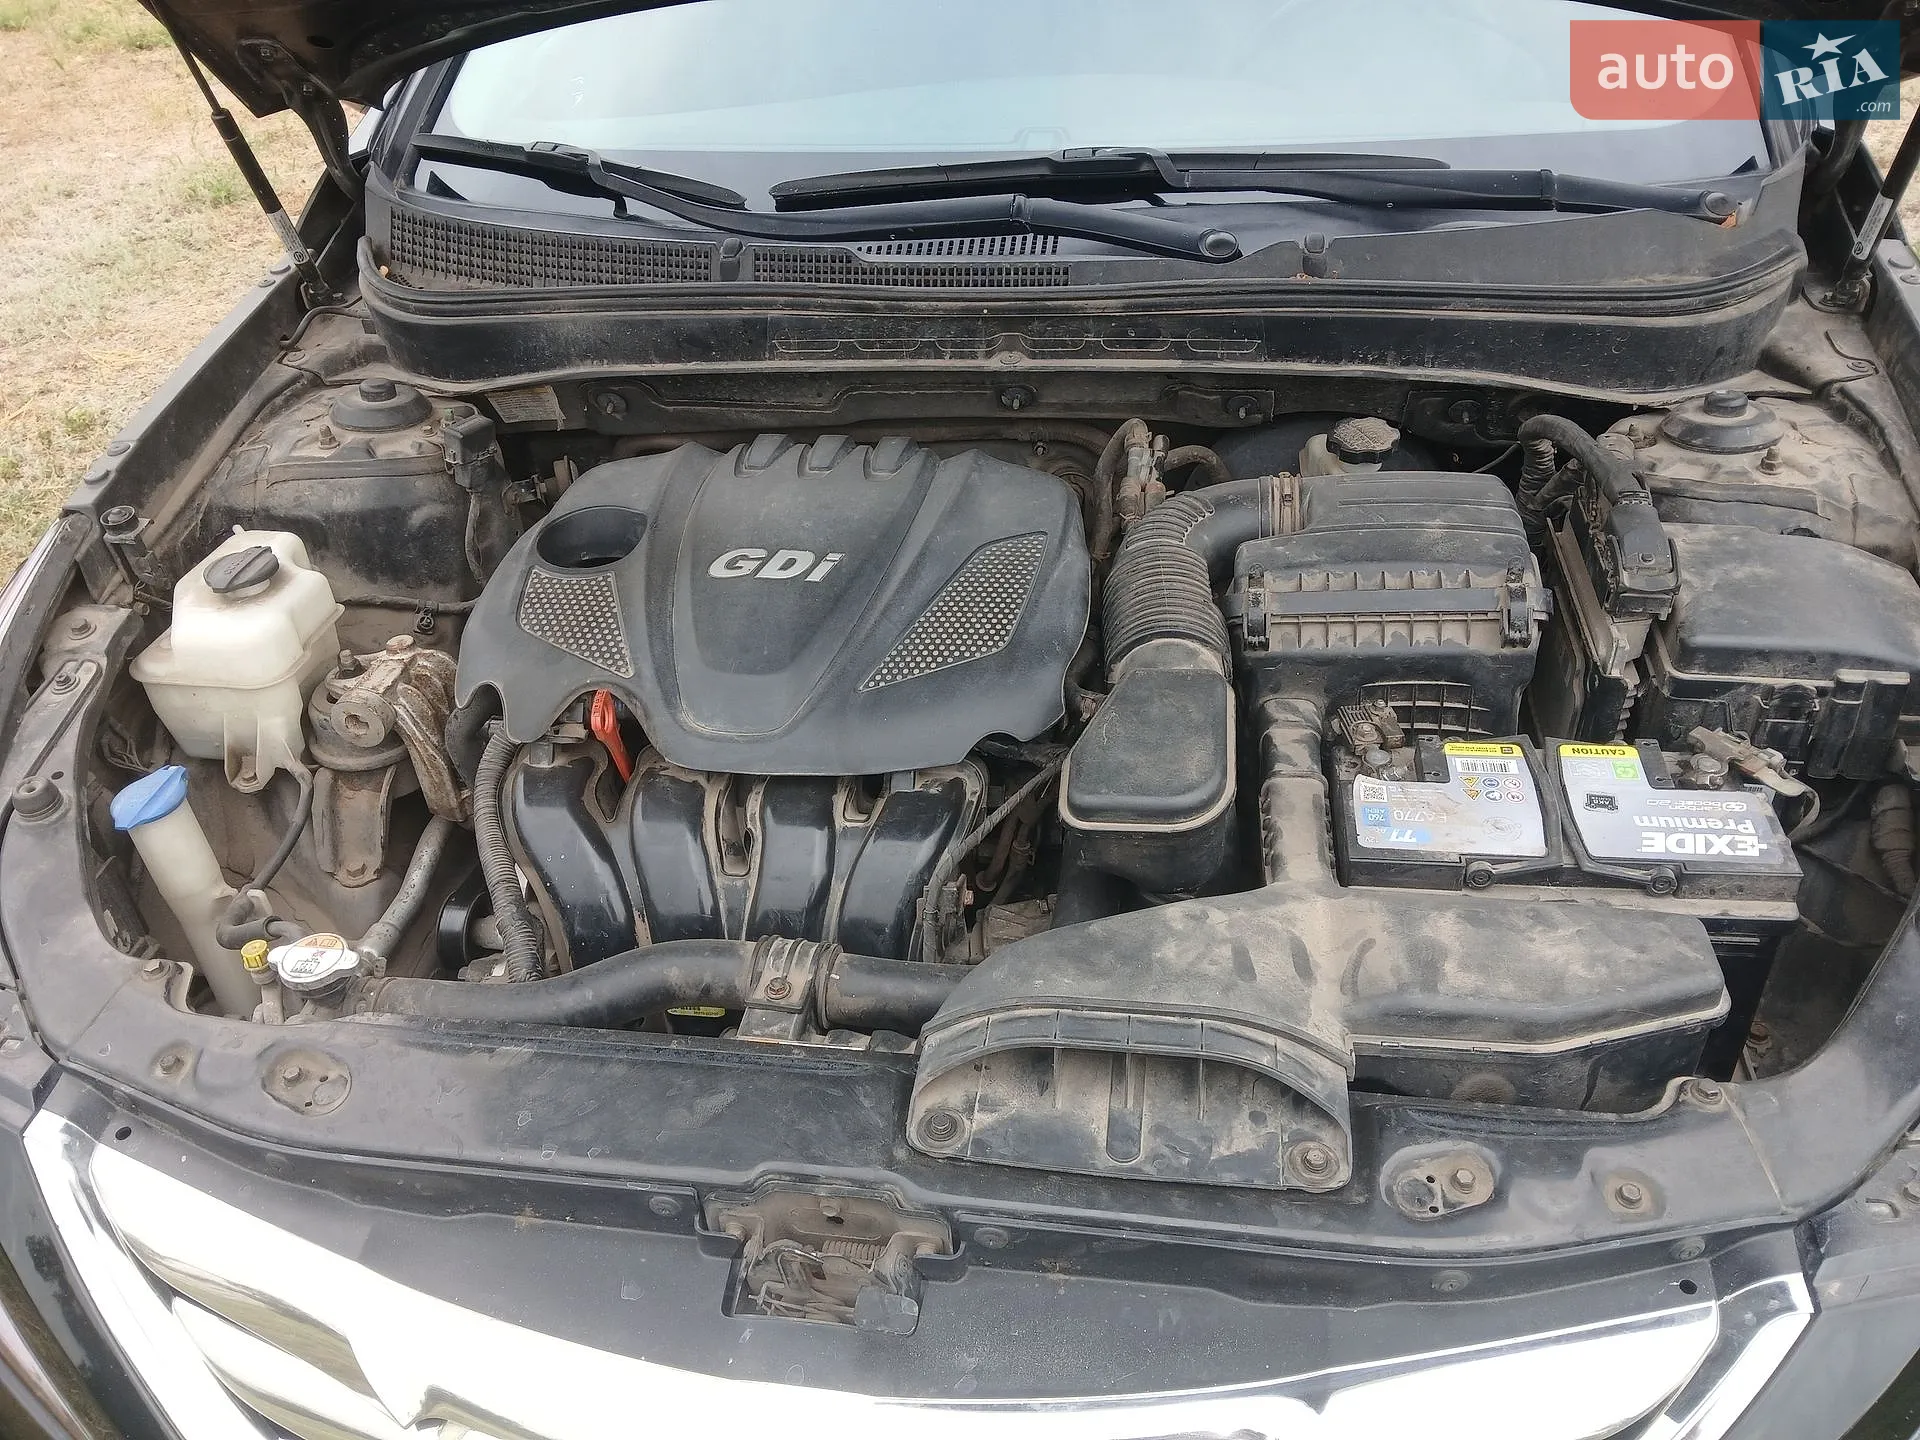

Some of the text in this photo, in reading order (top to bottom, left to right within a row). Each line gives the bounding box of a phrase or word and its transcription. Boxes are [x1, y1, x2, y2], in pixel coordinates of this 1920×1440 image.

[707, 548, 846, 582] GDi
[1571, 747, 1626, 756] CAUTION
[1368, 813, 1386, 821] 760
[1393, 809, 1447, 823] EA770
[1633, 815, 1756, 834] Premium
[1389, 829, 1417, 843] 77
[1641, 831, 1767, 857] EXIDE
